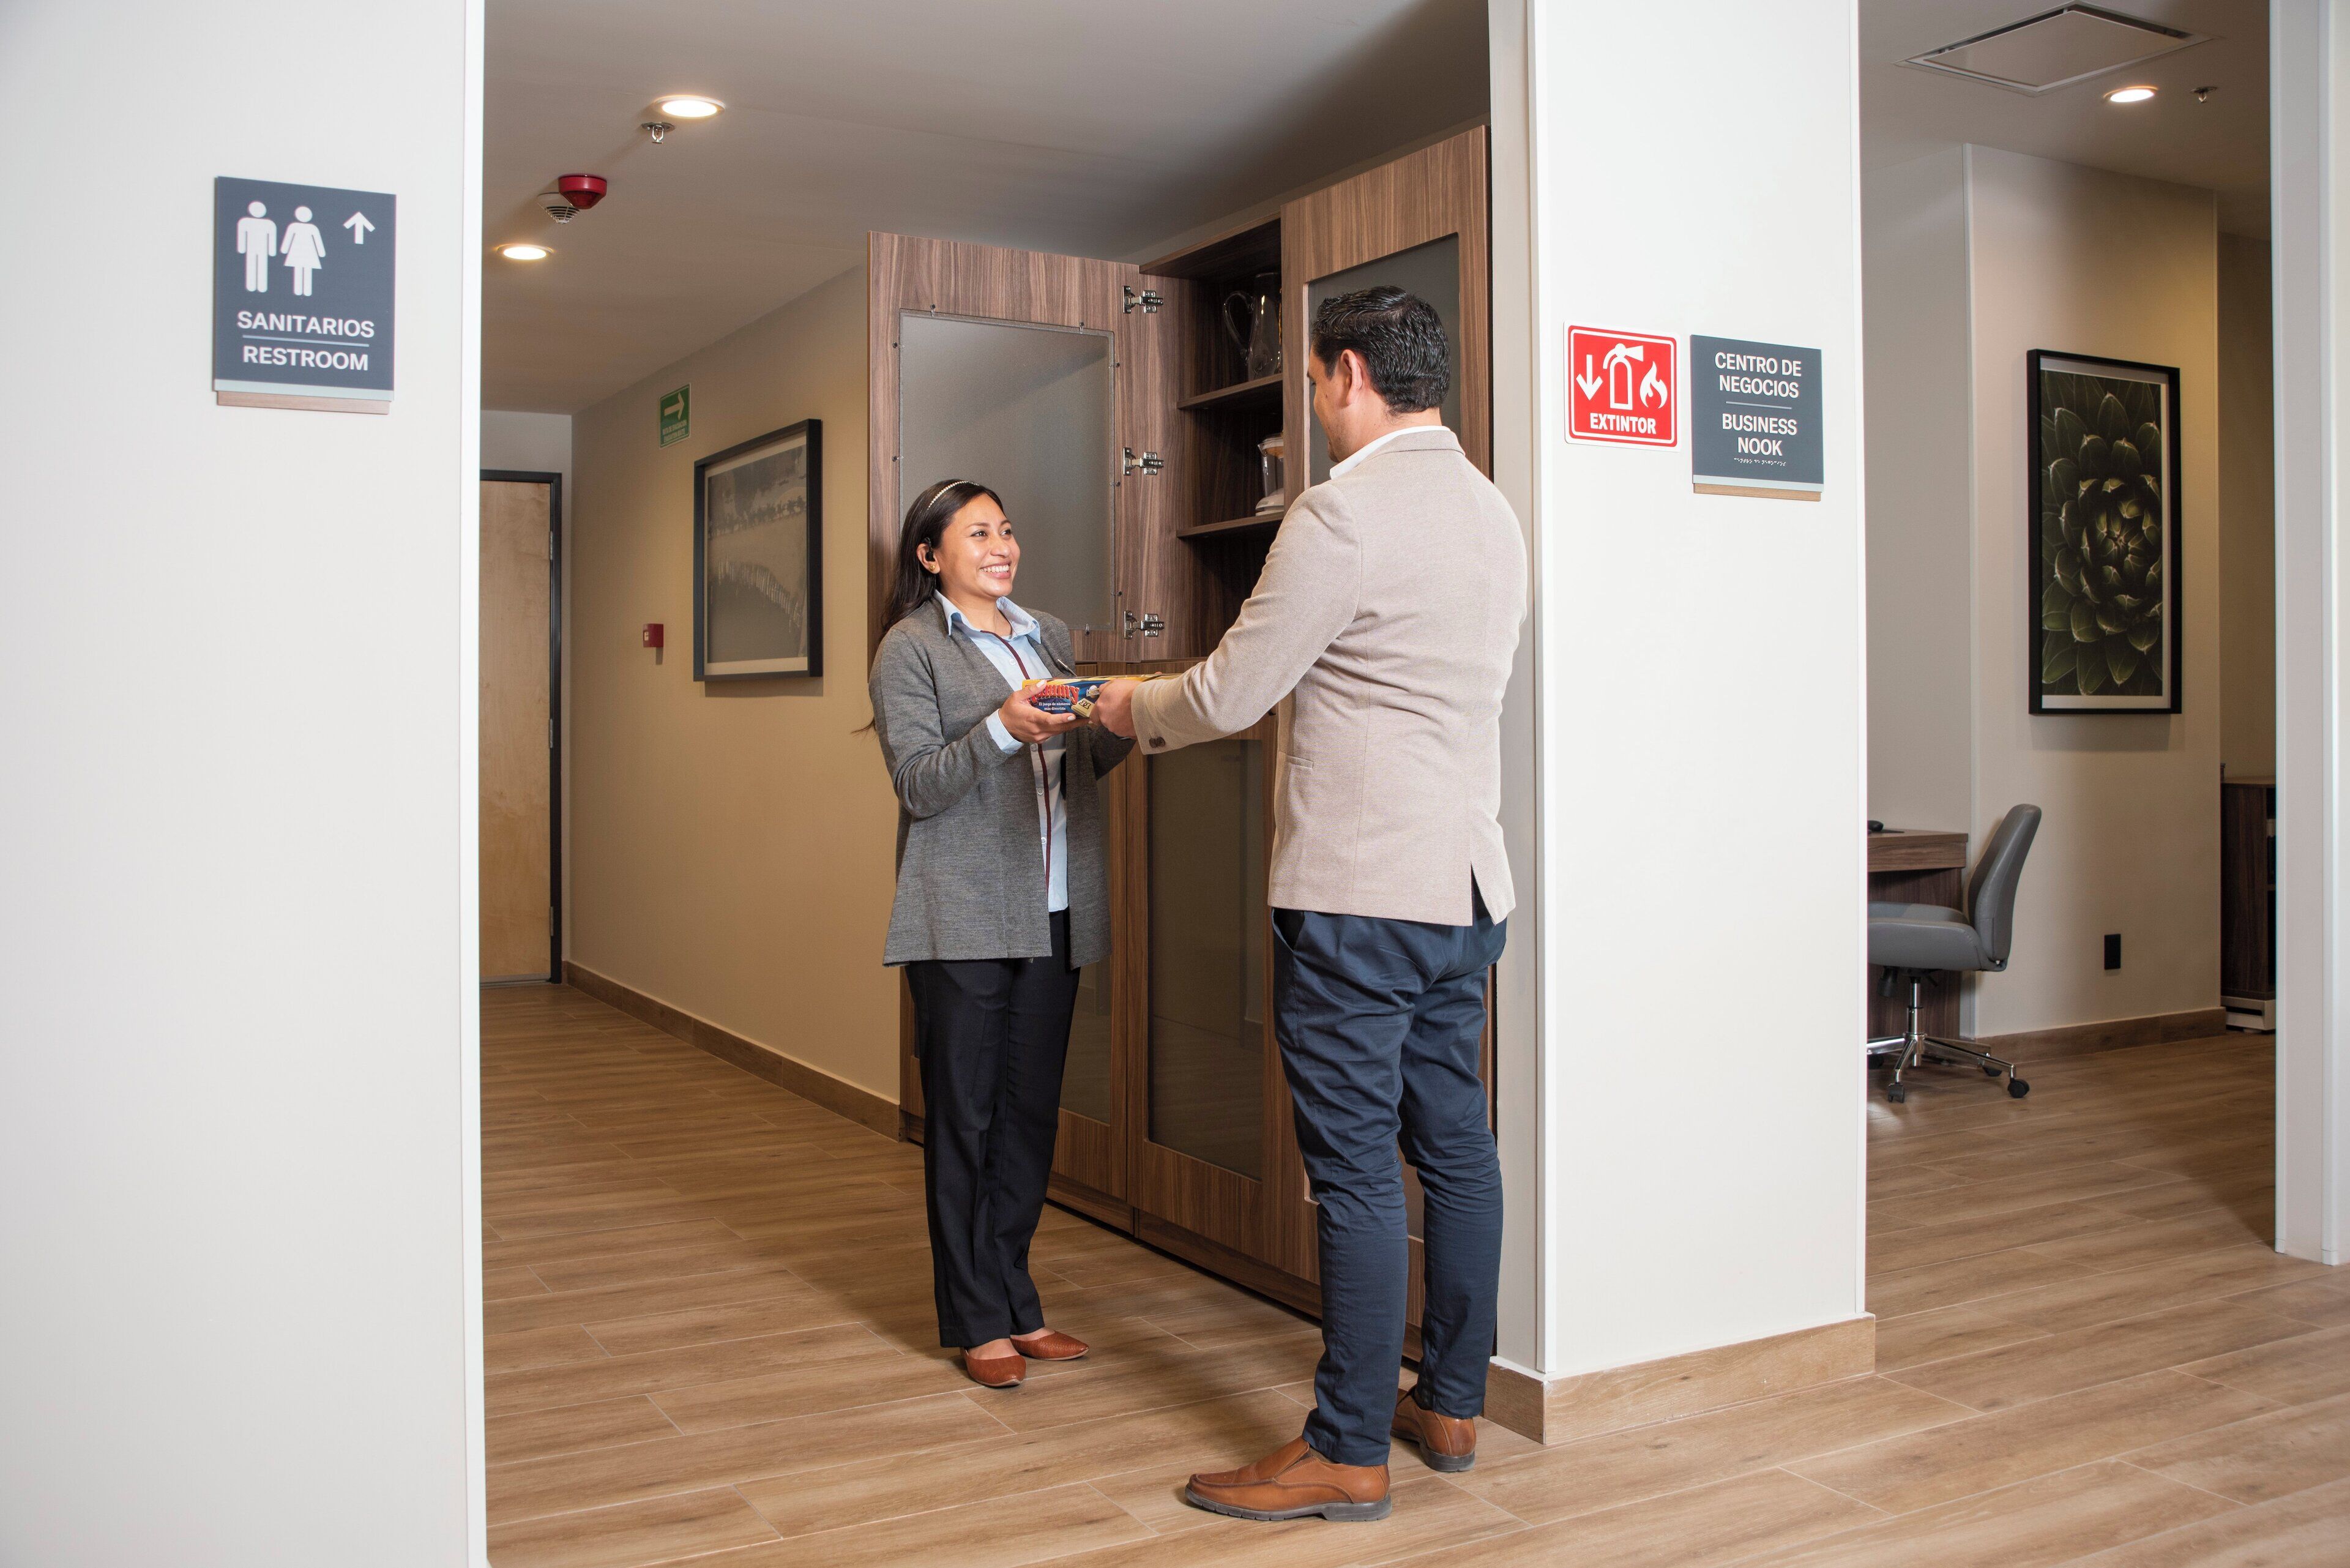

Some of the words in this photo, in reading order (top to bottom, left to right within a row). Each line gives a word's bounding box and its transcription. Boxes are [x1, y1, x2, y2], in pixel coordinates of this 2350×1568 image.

[237, 310, 375, 338] SANITARIOS
[243, 346, 368, 371] RESTROOM
[1715, 352, 1778, 375] CENTRO
[1781, 359, 1802, 377] DE
[1719, 375, 1799, 398] NEGOCIOS
[1590, 412, 1657, 435] EXTINTOR
[1722, 413, 1797, 436] BUSINESS
[1737, 436, 1783, 457] NOOK
